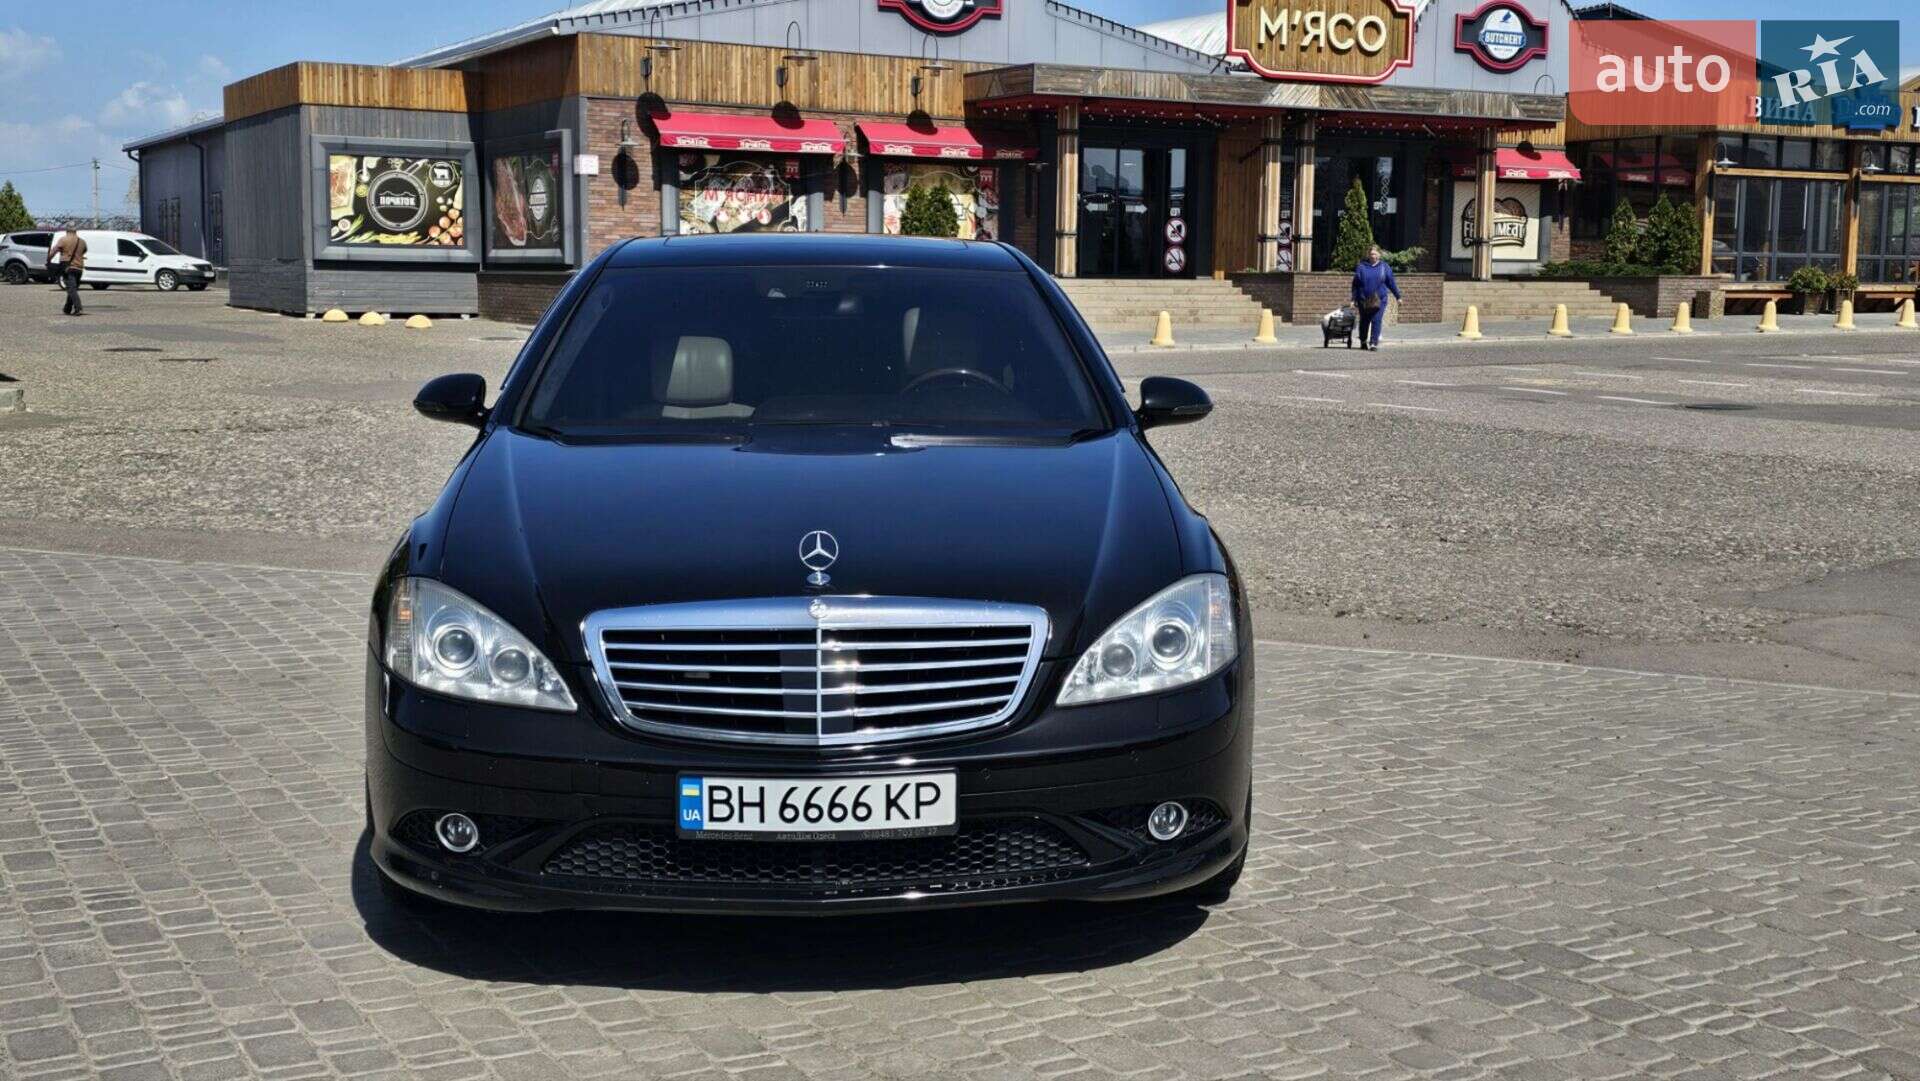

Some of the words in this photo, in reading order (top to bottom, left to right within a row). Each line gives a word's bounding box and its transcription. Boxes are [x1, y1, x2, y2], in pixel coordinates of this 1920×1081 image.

[1260, 7, 1387, 52] М'ЯСО
[683, 808, 700, 821] UA
[708, 785, 765, 823] BH
[779, 785, 872, 823] 6666
[885, 782, 941, 821] KP
